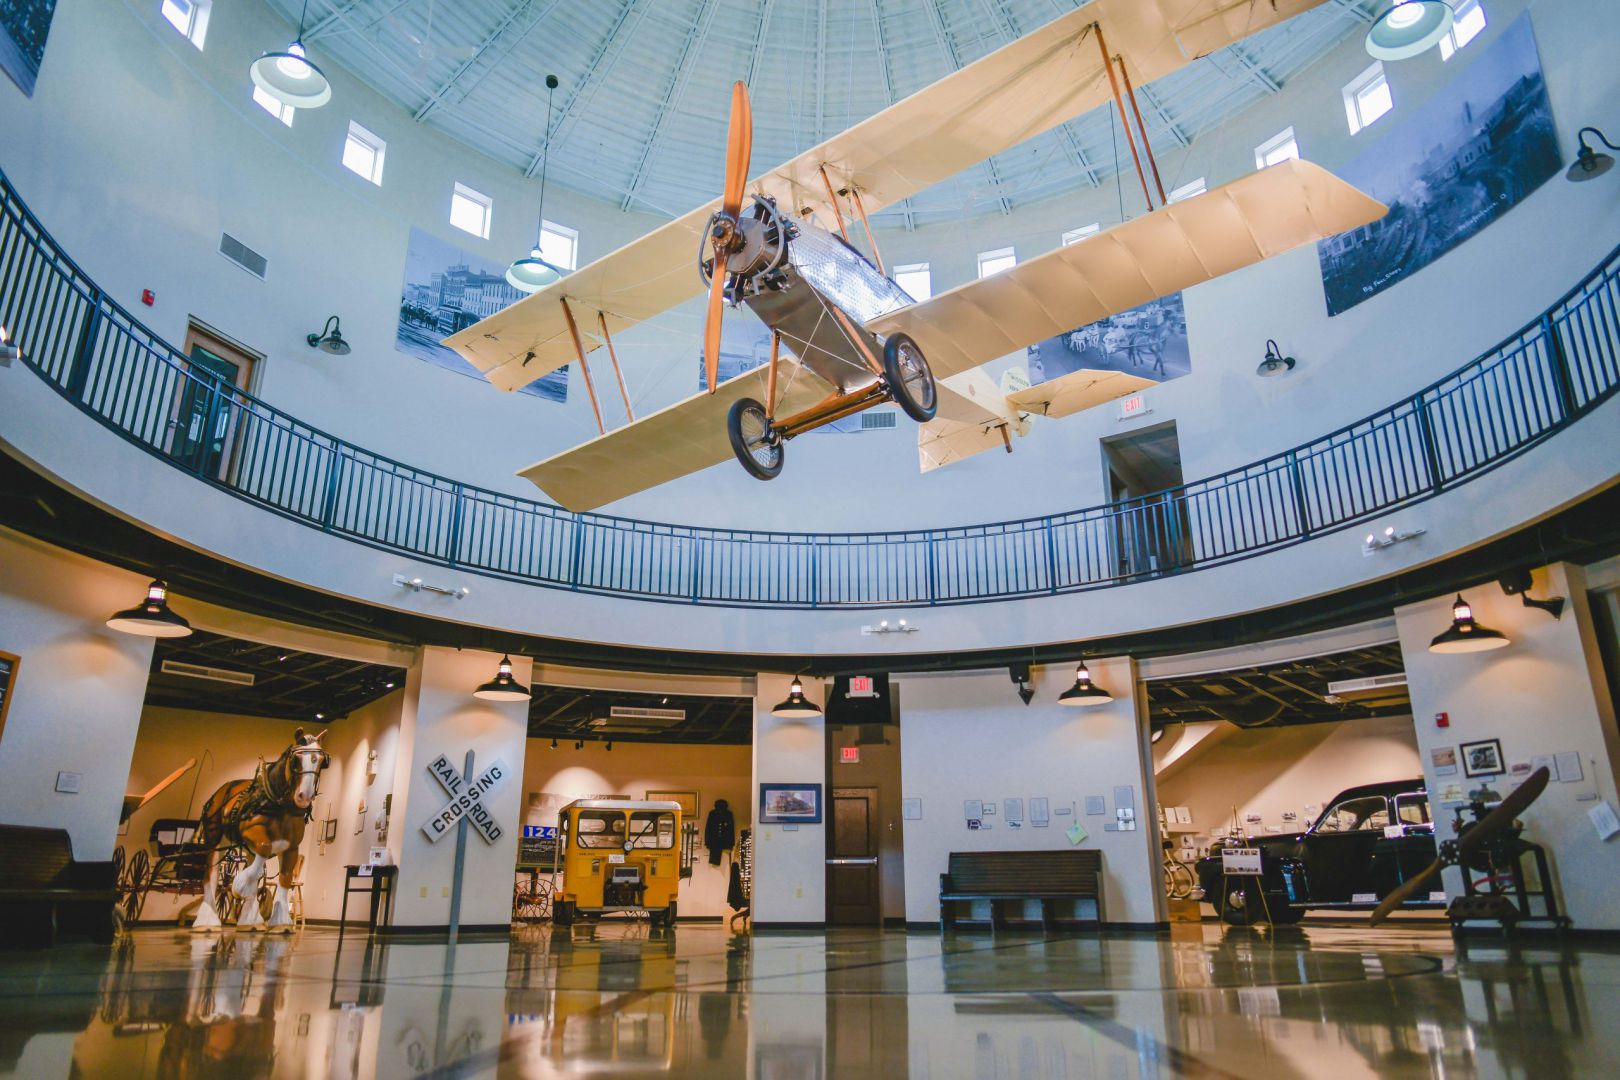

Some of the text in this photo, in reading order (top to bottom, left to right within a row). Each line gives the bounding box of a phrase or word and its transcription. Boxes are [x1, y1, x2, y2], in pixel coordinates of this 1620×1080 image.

[1125, 397, 1141, 412] EXIT
[853, 677, 870, 691] EXIT
[842, 747, 857, 760] EXIT
[431, 767, 503, 833] CROSSING
[433, 757, 502, 841] RAIL ROAD
[528, 826, 557, 839] 124
